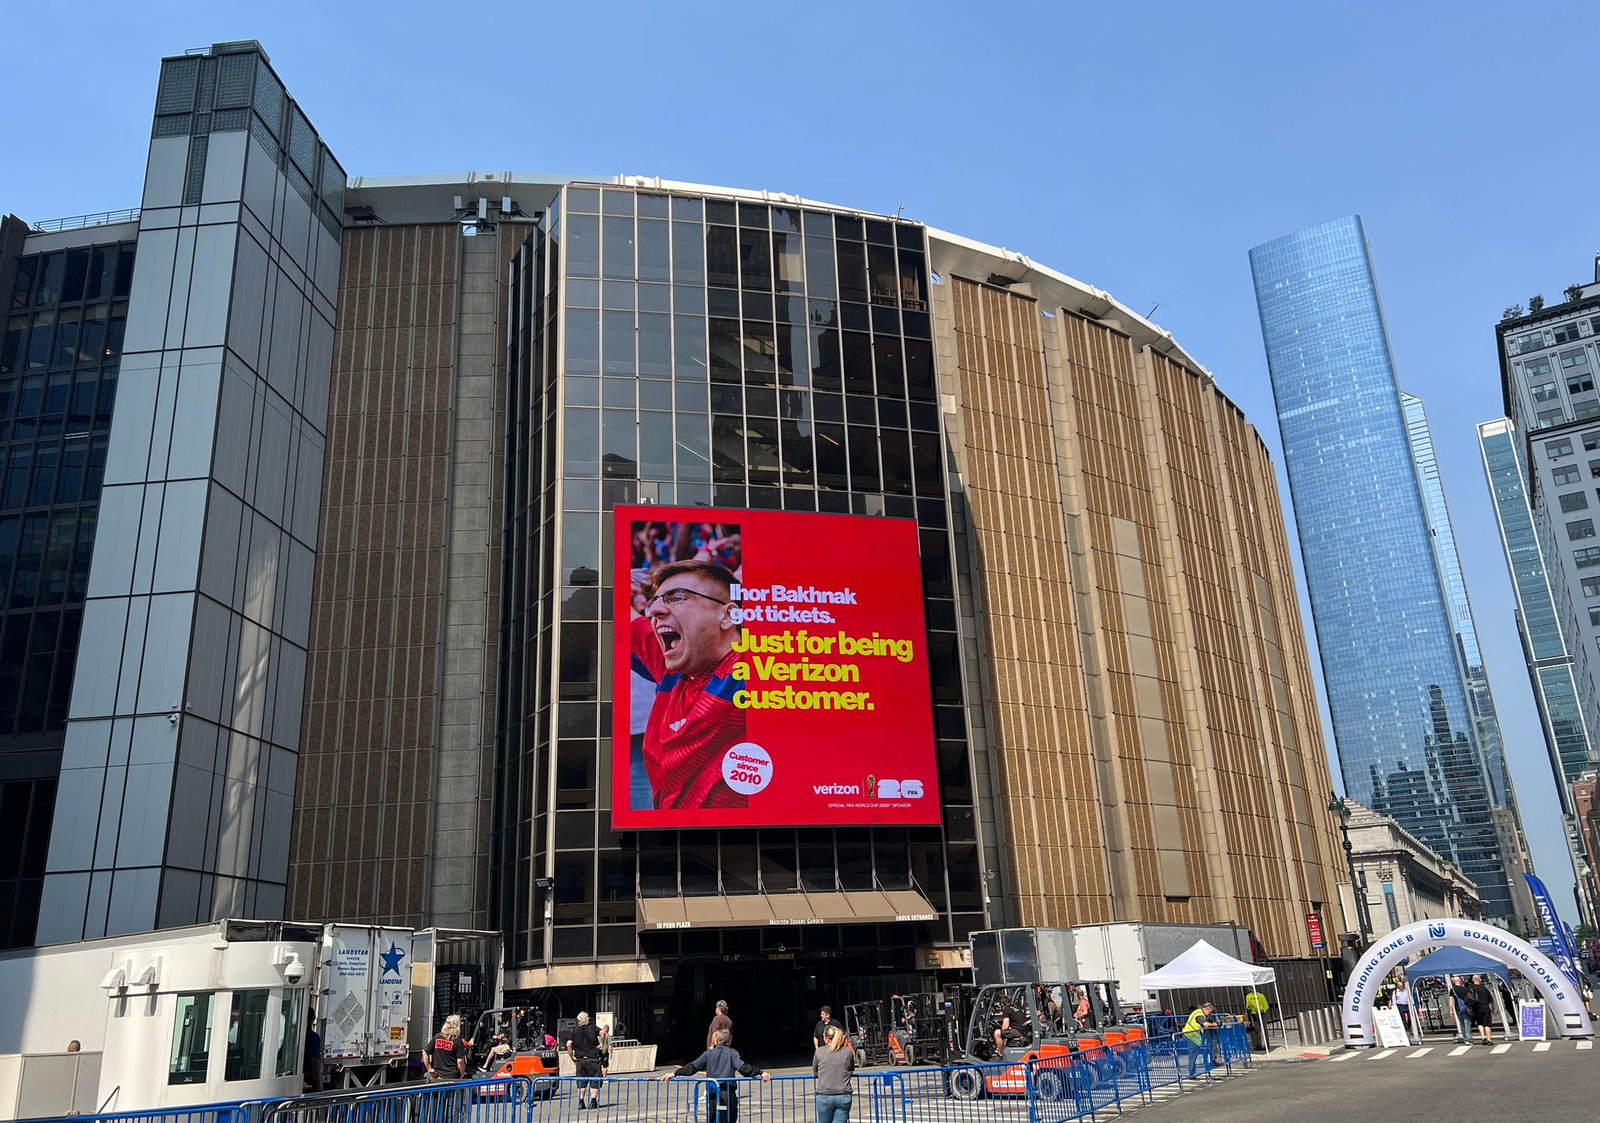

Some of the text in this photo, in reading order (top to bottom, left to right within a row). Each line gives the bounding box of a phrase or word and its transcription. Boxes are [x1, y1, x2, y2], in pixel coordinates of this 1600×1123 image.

[729, 583, 857, 605] Ihor Bakhnak
[729, 605, 836, 625] got tickets.
[731, 628, 913, 662] Just for being
[731, 656, 859, 682] a Verizon
[732, 685, 875, 710] customer.
[729, 751, 770, 766] Customer
[736, 762, 759, 772] since
[729, 769, 762, 785] 2010
[813, 783, 860, 795] verizon
[1352, 934, 1414, 1012] BOARDING ZONE B
[1463, 930, 1565, 1000] BOARDING ZONE B
